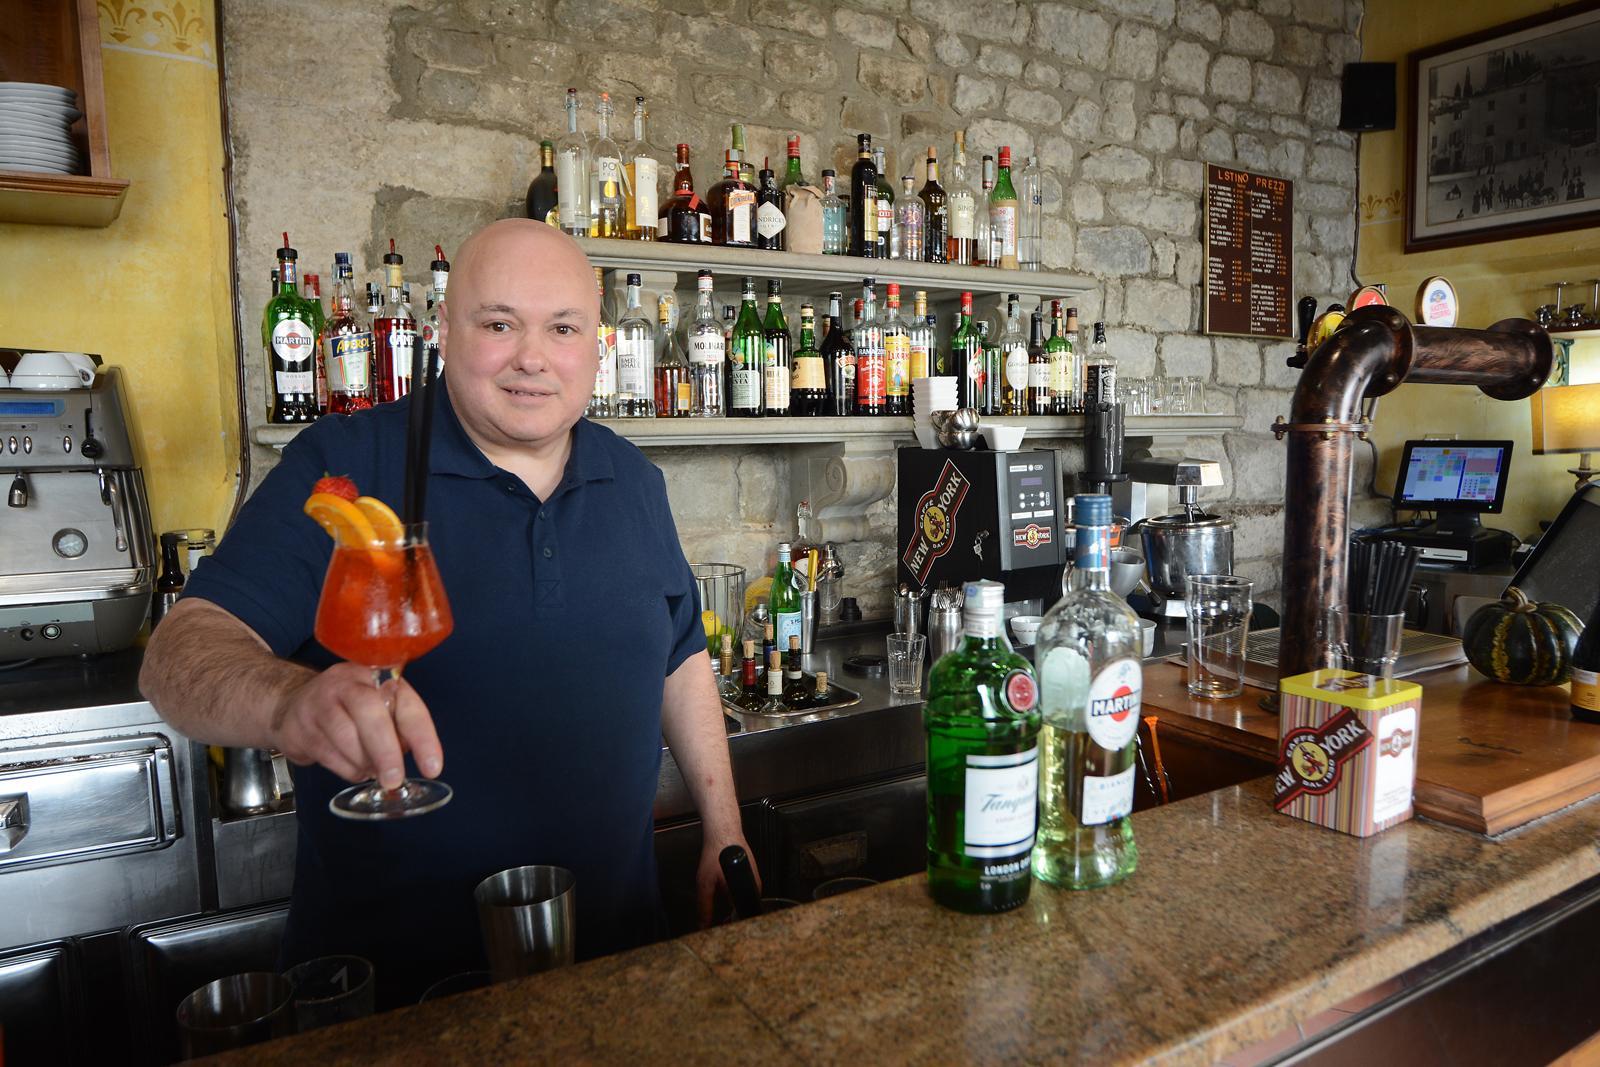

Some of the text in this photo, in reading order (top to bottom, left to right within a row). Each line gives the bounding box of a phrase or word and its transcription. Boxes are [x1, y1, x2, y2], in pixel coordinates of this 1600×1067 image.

[1256, 177, 1285, 192] PREZZI
[275, 335, 311, 345] MARTINI
[336, 338, 369, 353] APEROL
[937, 471, 962, 513] YORK
[932, 541, 945, 549] DAL
[910, 535, 929, 574] NEW
[1319, 720, 1366, 755] YORK
[1302, 780, 1323, 788] DAL
[984, 861, 1020, 876] LONDON
